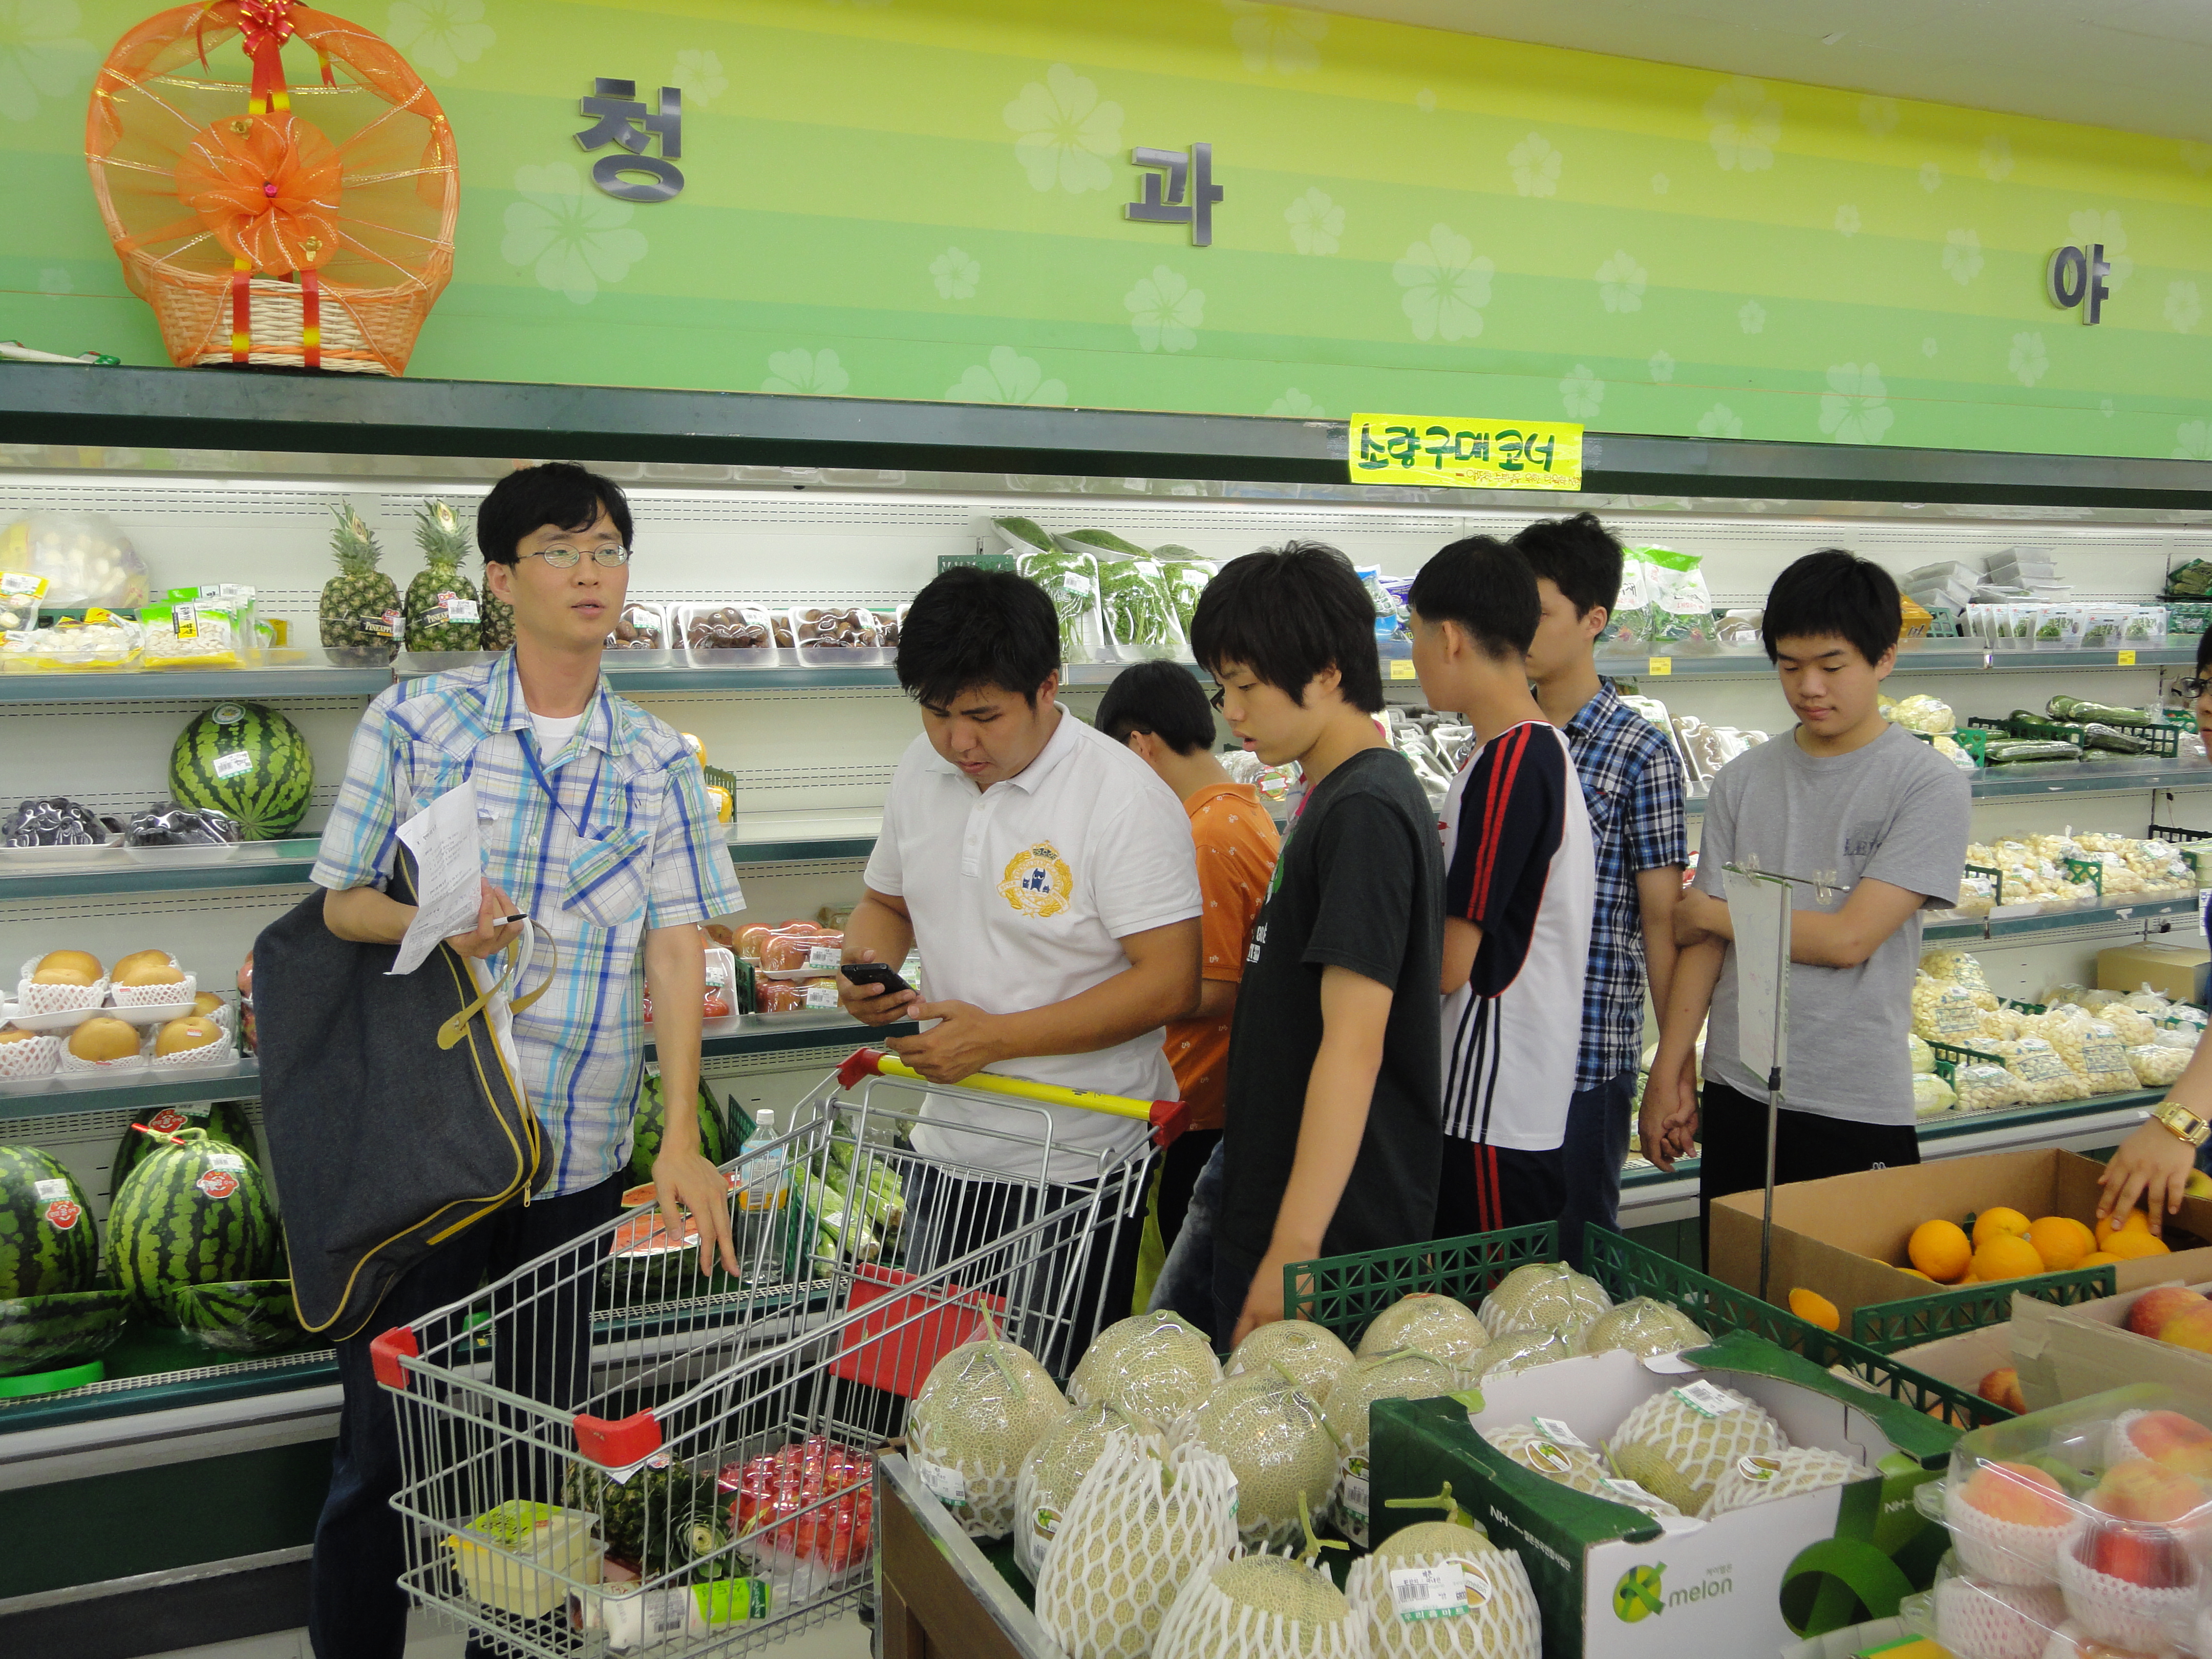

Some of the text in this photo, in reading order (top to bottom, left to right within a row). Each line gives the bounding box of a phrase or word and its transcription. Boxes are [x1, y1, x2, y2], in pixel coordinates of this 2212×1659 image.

[572, 77, 2111, 326] 청 과 야
[1358, 423, 1555, 472] 소량 구매 코너
[439, 591, 456, 601] Dole
[365, 622, 394, 632] PINEAPPL
[426, 612, 449, 623] PINEAP
[1490, 1504, 1508, 1527] NH
[1669, 1578, 1733, 1608] melon
